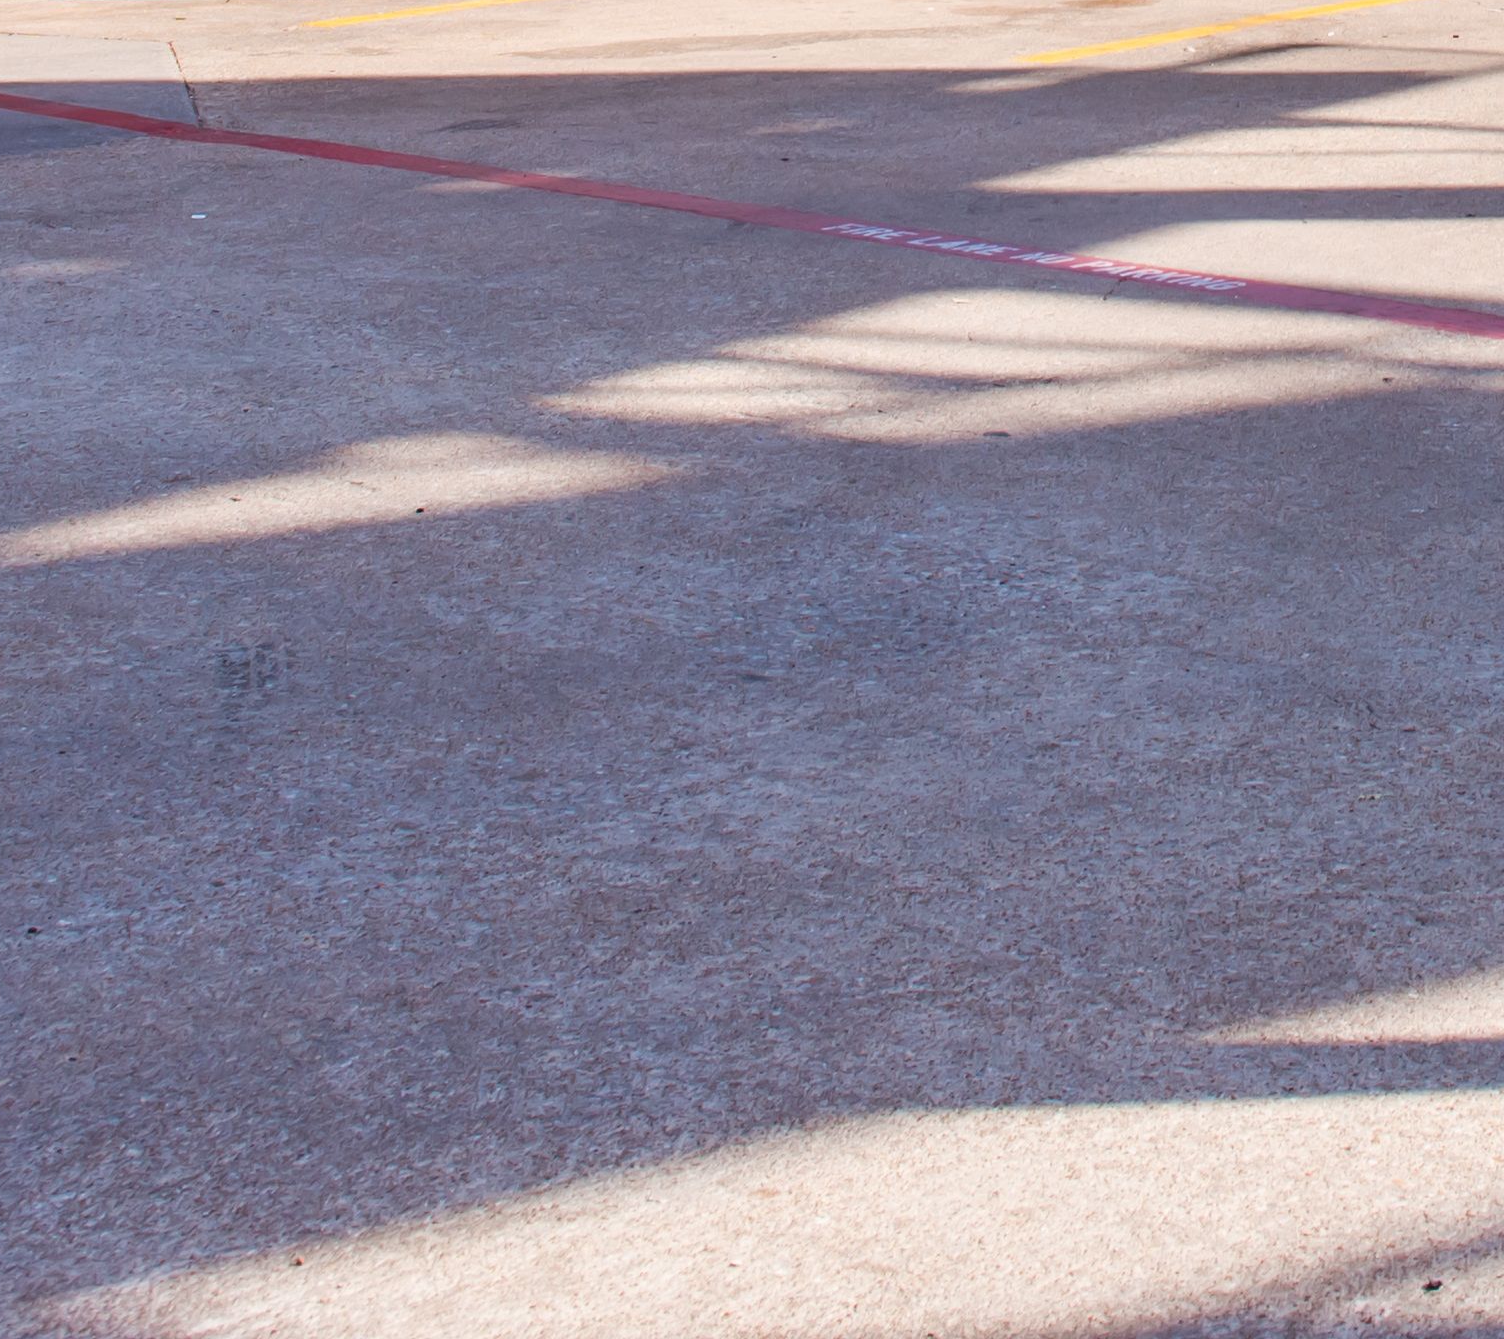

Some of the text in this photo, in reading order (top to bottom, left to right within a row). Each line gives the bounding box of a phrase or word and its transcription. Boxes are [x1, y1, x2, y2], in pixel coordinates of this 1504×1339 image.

[821, 223, 1247, 291] FIRE LANE NO PARKING
